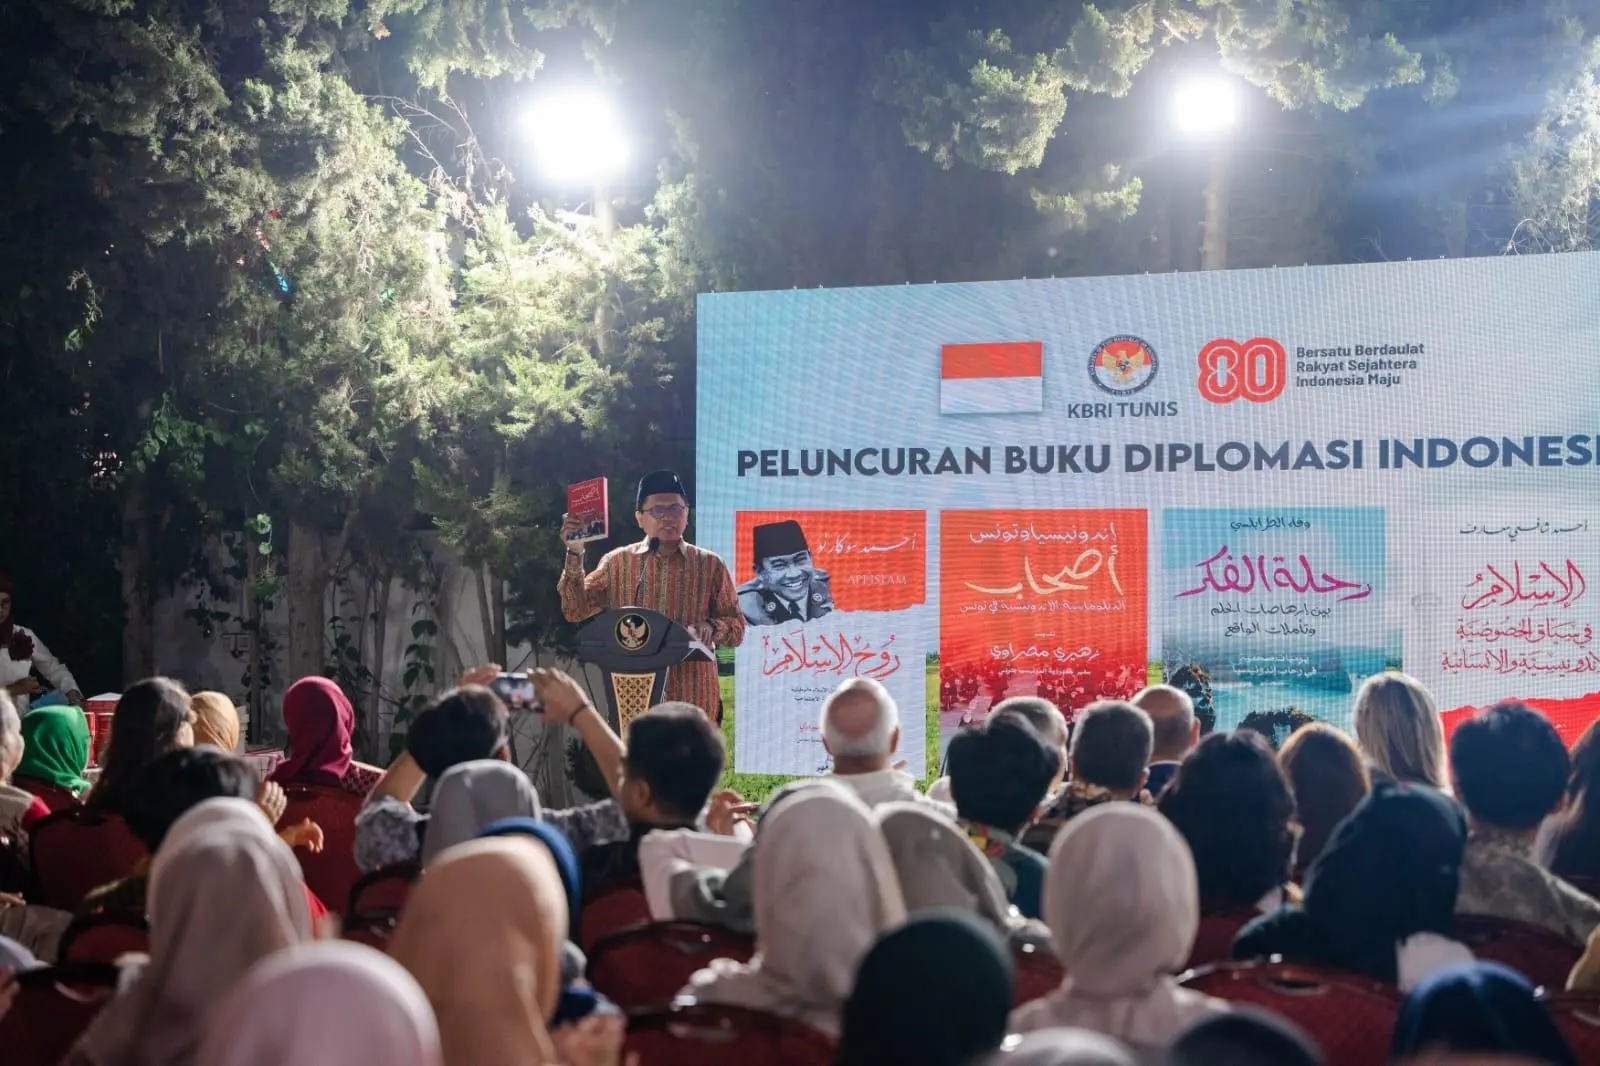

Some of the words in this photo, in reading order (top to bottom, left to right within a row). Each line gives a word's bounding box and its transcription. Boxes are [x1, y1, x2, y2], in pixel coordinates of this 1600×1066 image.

[1296, 346, 1351, 358] Bersatu
[1355, 344, 1425, 356] Berdaulat
[1198, 337, 1286, 404] 80
[1296, 361, 1345, 374] Rakyat
[1348, 359, 1417, 373] Sejahtera
[1296, 375, 1365, 388] Indonesia
[1368, 374, 1401, 388] Maju
[1067, 402, 1112, 419] KBRI
[1116, 401, 1178, 418] TUNIS
[738, 446, 992, 477] PELUNCURAN
[1004, 444, 1111, 475] BUKU
[1124, 439, 1362, 473] DIPLOMASI
[870, 574, 907, 585] ISLAM
[964, 544, 1124, 600] أصحاب
[1175, 545, 1271, 599] الفكر
[1273, 554, 1372, 602] رحلة
